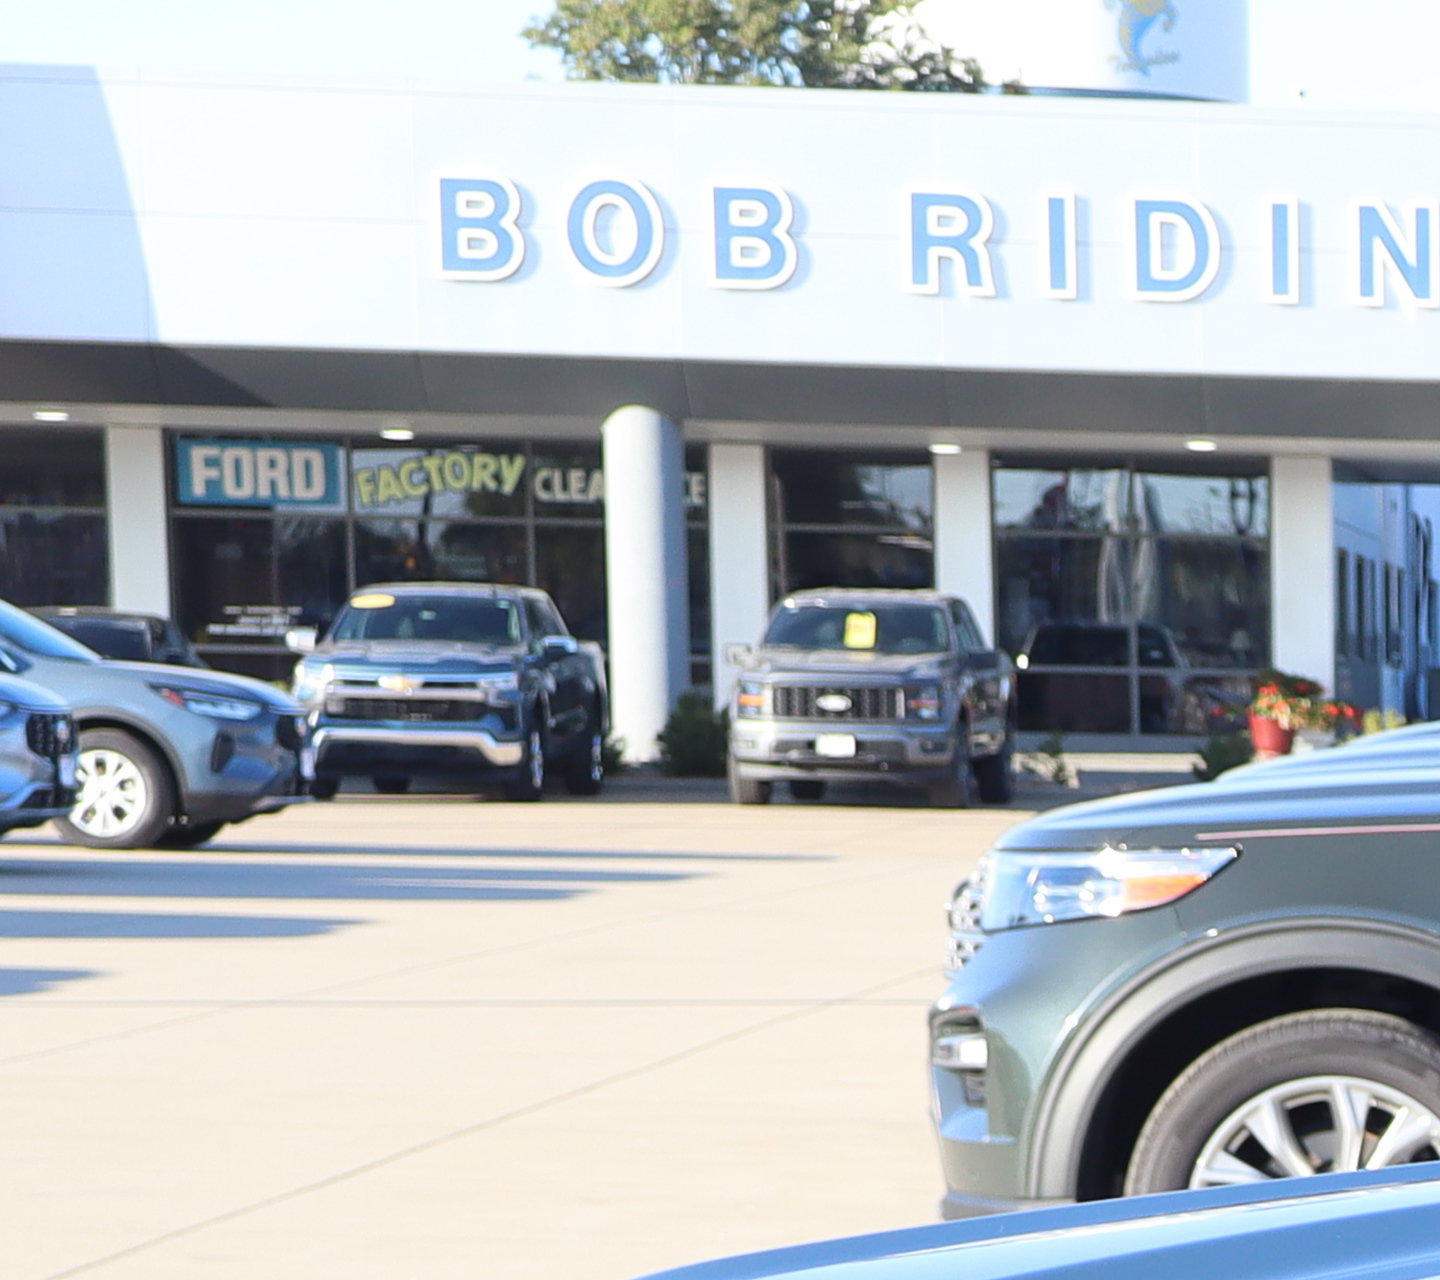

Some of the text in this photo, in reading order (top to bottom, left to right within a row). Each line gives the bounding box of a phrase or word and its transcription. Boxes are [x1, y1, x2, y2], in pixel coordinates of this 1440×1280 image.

[436, 174, 798, 290] BOB
[191, 446, 326, 500] FORD
[353, 453, 527, 506] FACTORY
